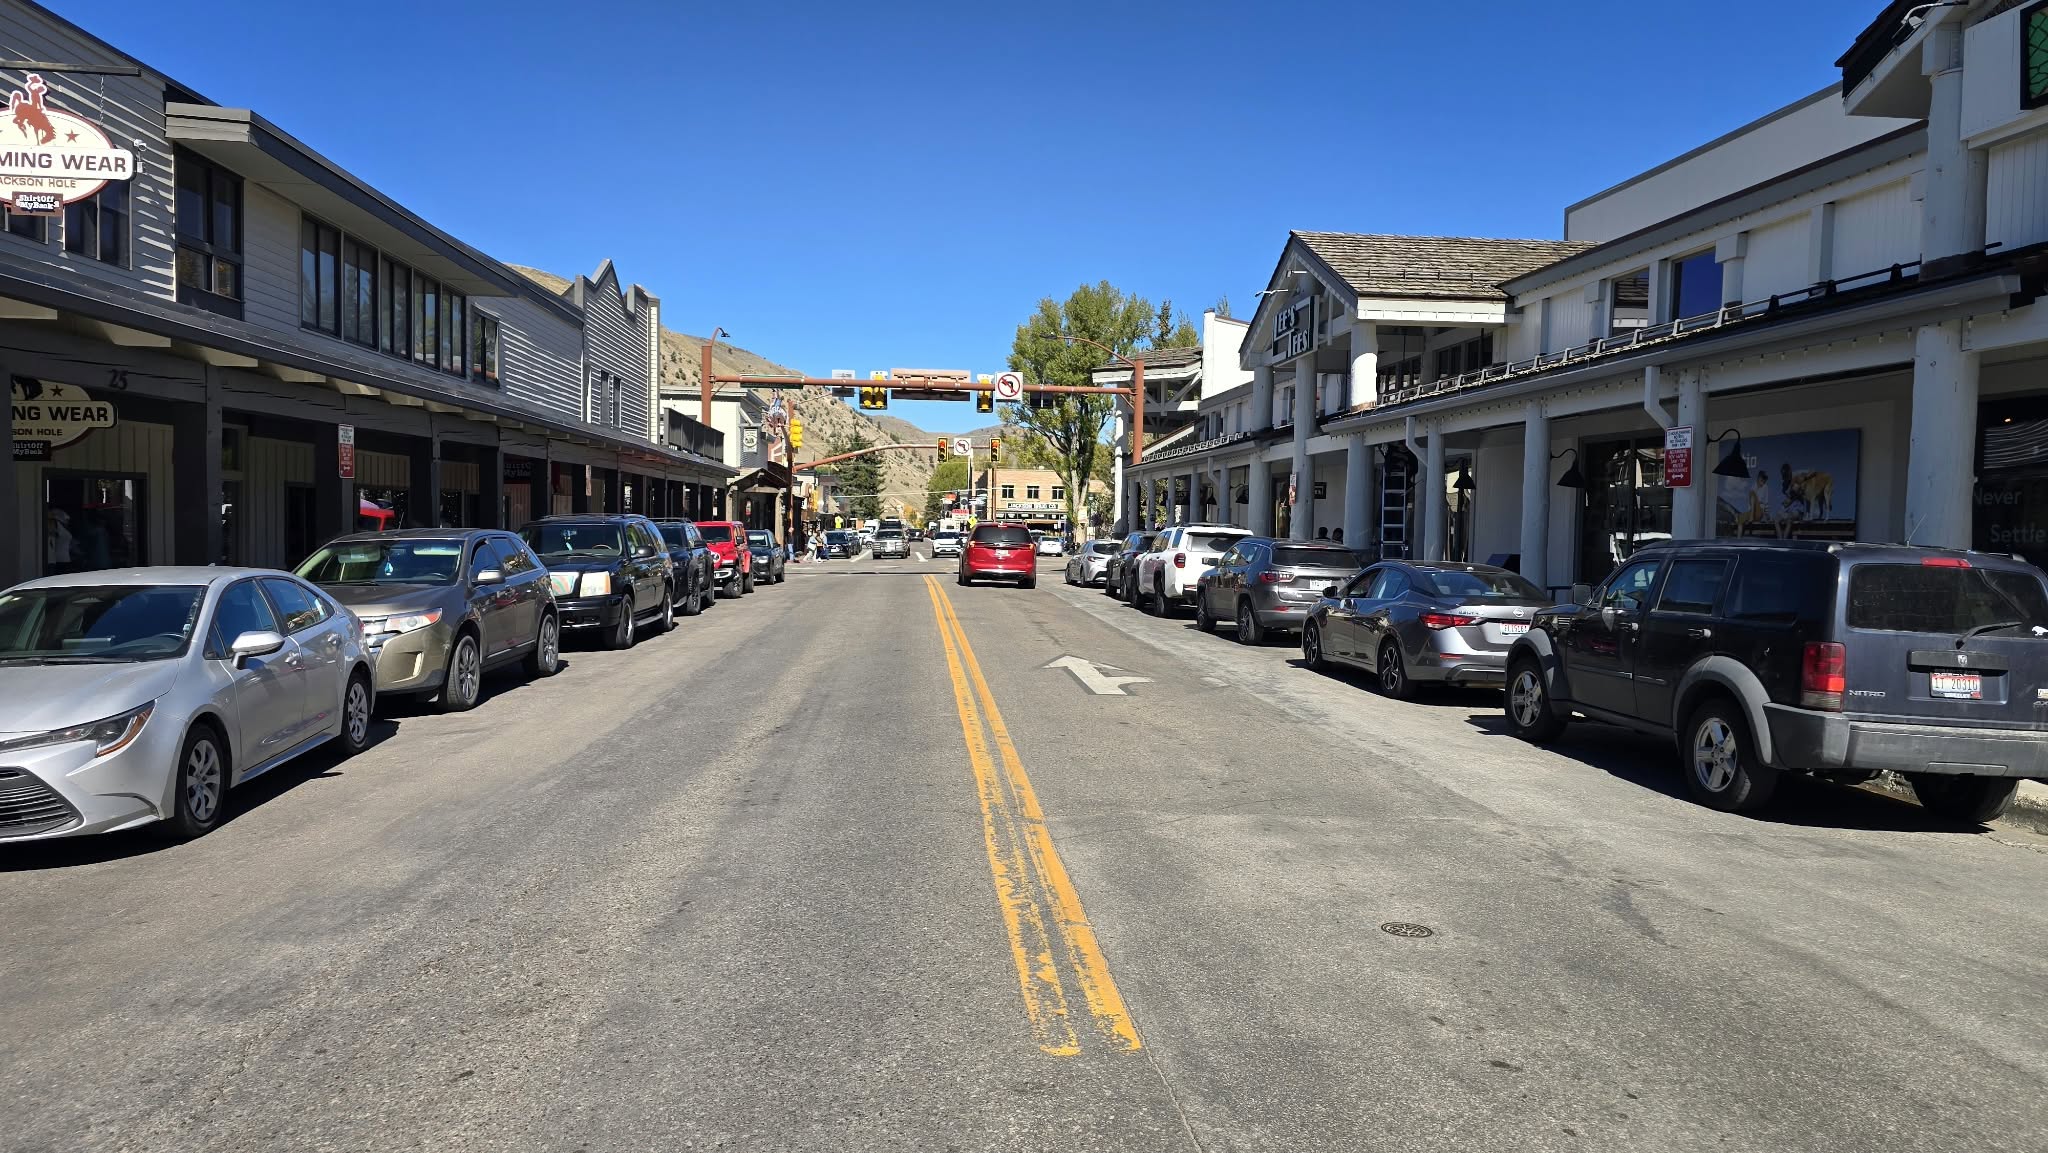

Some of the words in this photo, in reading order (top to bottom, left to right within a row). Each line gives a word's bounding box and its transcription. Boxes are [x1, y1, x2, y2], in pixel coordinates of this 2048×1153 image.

[62, 154, 126, 172] WEAR
[49, 179, 76, 188] HOLE
[1274, 305, 1295, 341] LEE'S
[1286, 329, 1308, 358] TEES
[110, 370, 128, 389] 25
[48, 406, 108, 421] WEAR
[37, 428, 63, 436] HOLE
[1973, 488, 2022, 505] Never
[1990, 523, 2047, 543] Settle
[1848, 689, 1887, 698] NITRO
